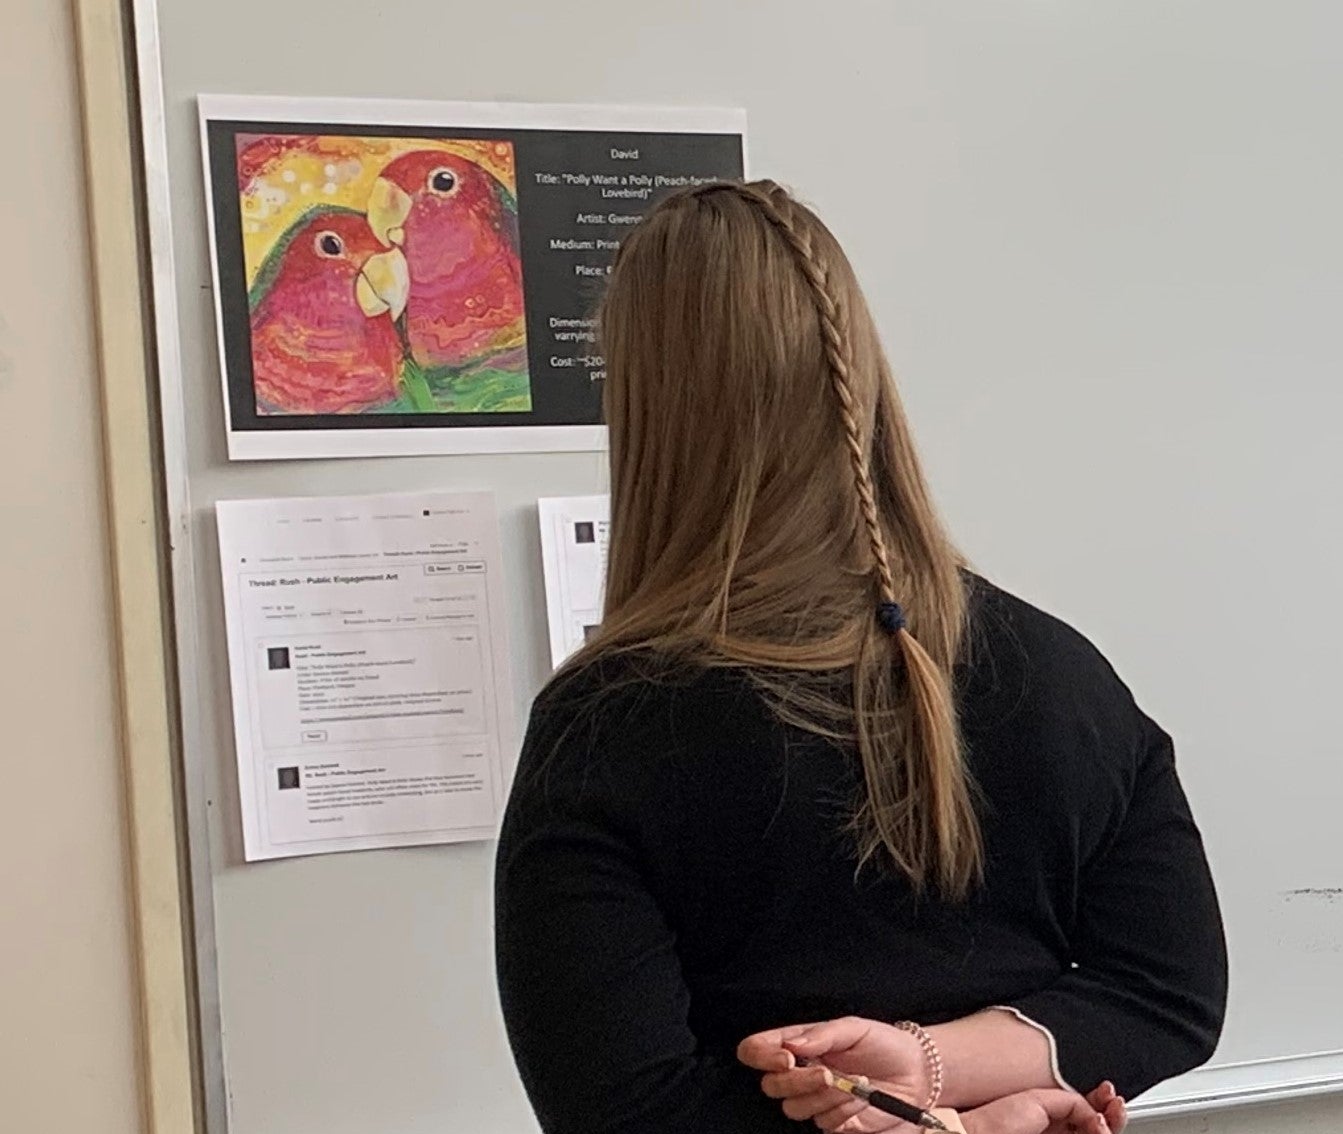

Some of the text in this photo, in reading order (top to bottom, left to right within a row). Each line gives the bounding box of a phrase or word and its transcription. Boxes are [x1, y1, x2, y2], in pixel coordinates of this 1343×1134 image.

[610, 148, 639, 160] David
[534, 173, 560, 185] Title:
[592, 174, 619, 186] Want
[621, 177, 627, 186] a
[629, 175, 653, 187] Polly
[576, 213, 606, 225] Artist:
[550, 239, 594, 250] Medium:
[575, 265, 604, 276] Place:
[550, 356, 576, 367] Cost:
[306, 576, 332, 585] Public
[333, 574, 385, 585] Engagement
[385, 572, 399, 581] Art
